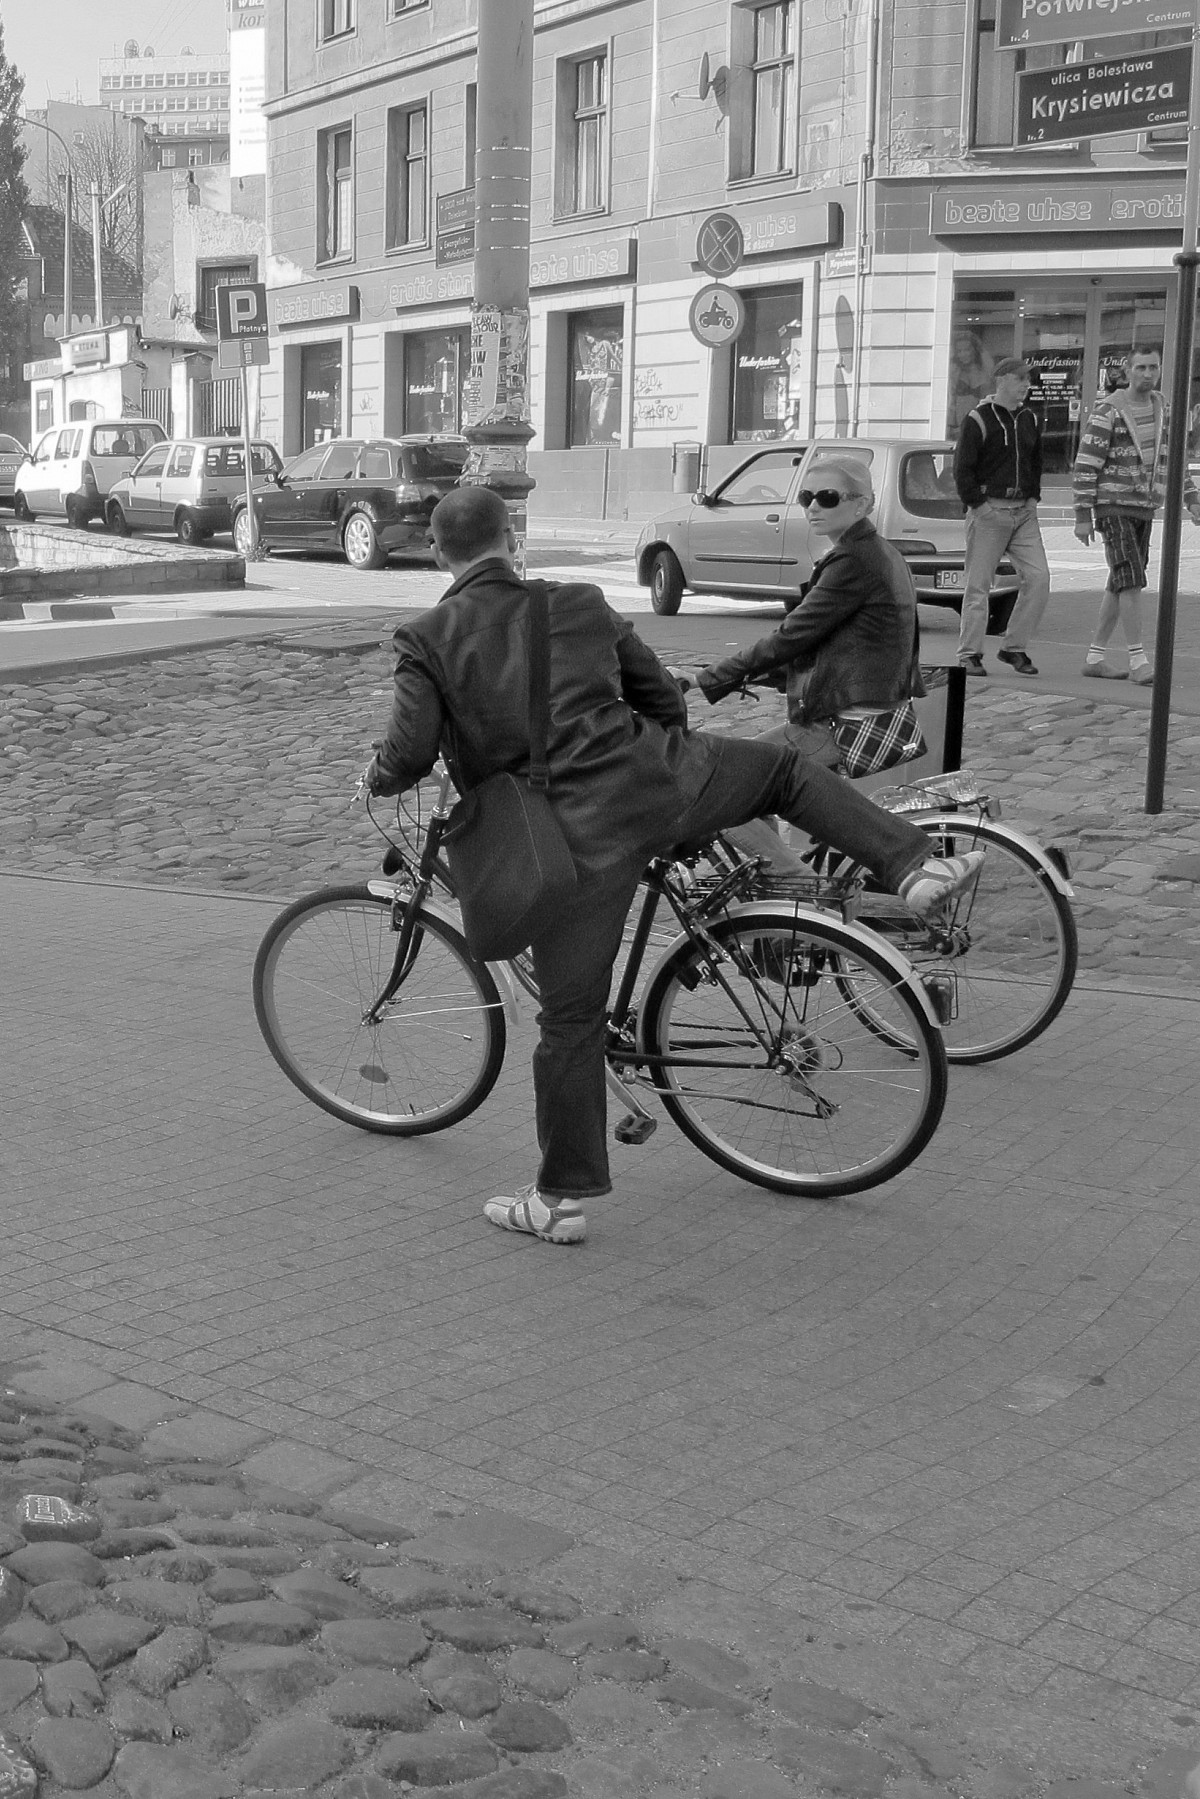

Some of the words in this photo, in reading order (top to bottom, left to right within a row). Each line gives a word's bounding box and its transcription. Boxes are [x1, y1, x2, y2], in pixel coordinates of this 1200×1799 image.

[1147, 10, 1191, 23] Centrum
[1051, 73, 1081, 86] ulica
[1088, 60, 1153, 80] Bolesława
[1032, 82, 1174, 122] Krysiewicza
[1147, 110, 1187, 122] Centrum
[945, 200, 1020, 224] beate
[1027, 197, 1092, 221] uhse
[756, 215, 797, 238] uhse
[530, 254, 568, 285] eate
[572, 247, 619, 278] uhse
[390, 275, 433, 305] erotic
[229, 290, 258, 334] P
[275, 297, 309, 322] beate
[311, 291, 344, 316] uhse
[942, 571, 959, 585] PO
